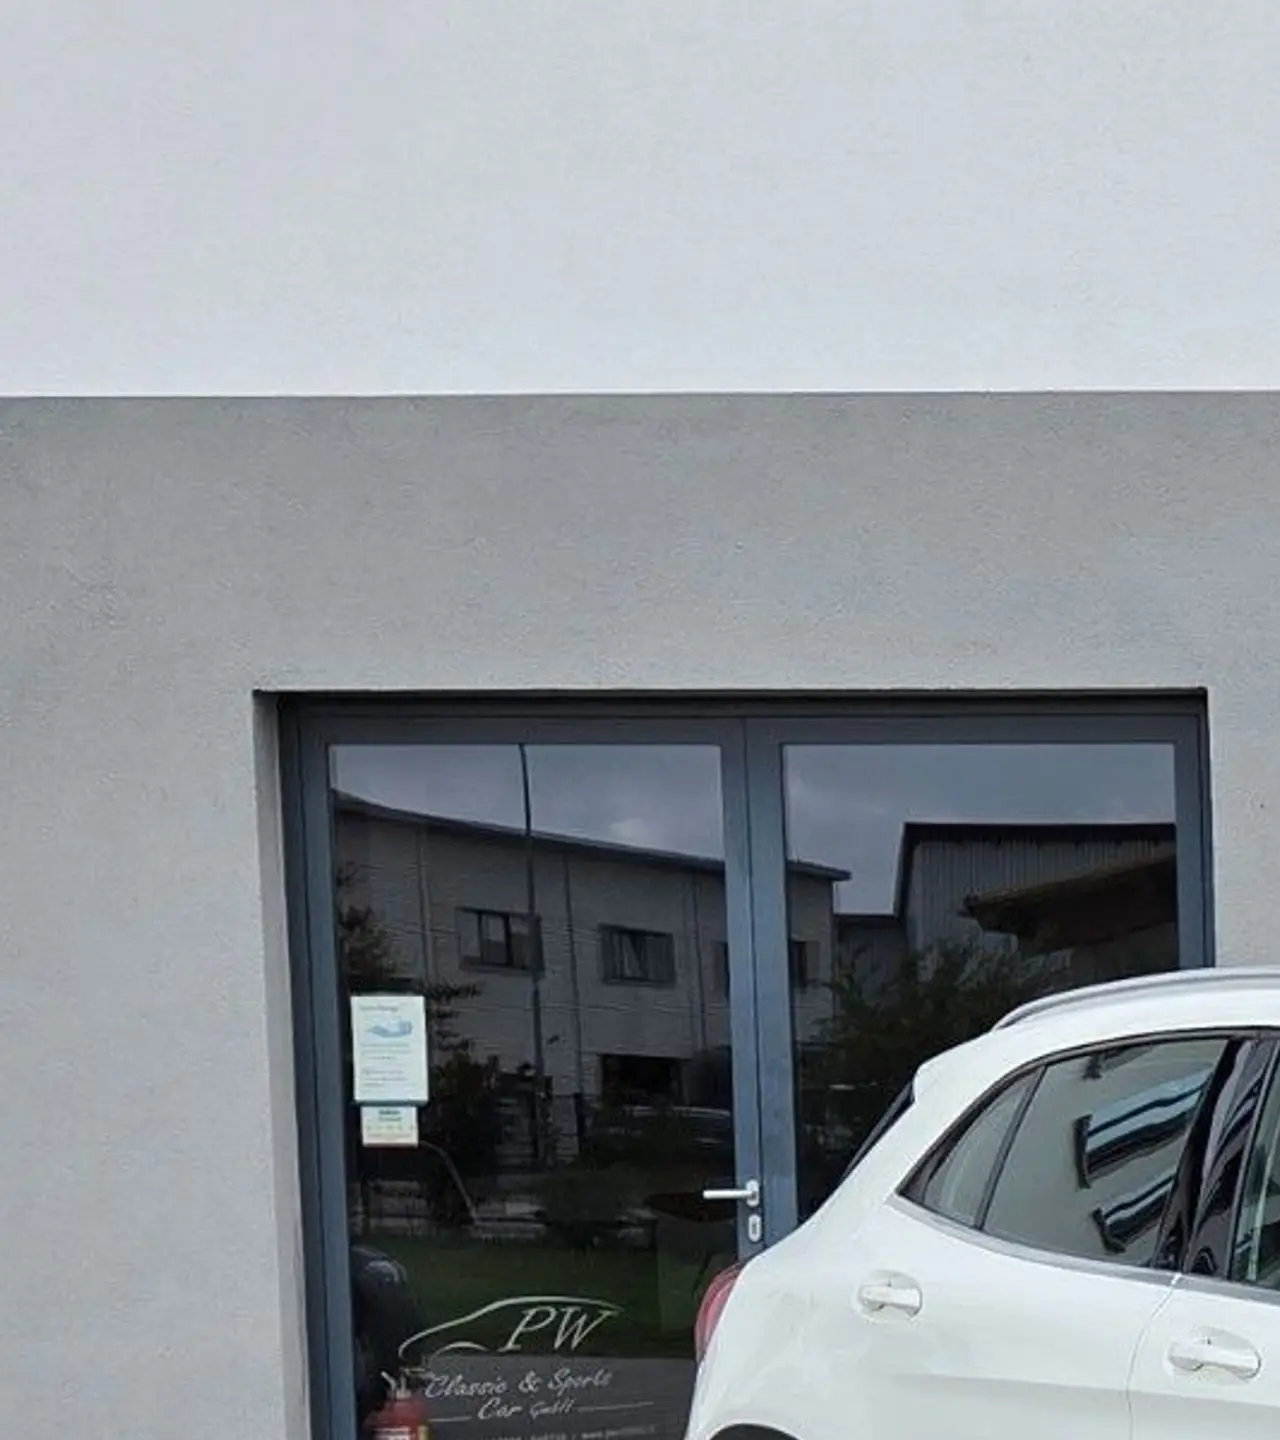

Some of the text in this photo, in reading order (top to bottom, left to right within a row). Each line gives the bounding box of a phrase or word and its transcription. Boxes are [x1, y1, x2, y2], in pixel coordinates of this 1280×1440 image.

[499, 1306, 618, 1352] PW
[422, 1367, 613, 1399] Classic & Sports
[477, 1397, 523, 1420] Car
